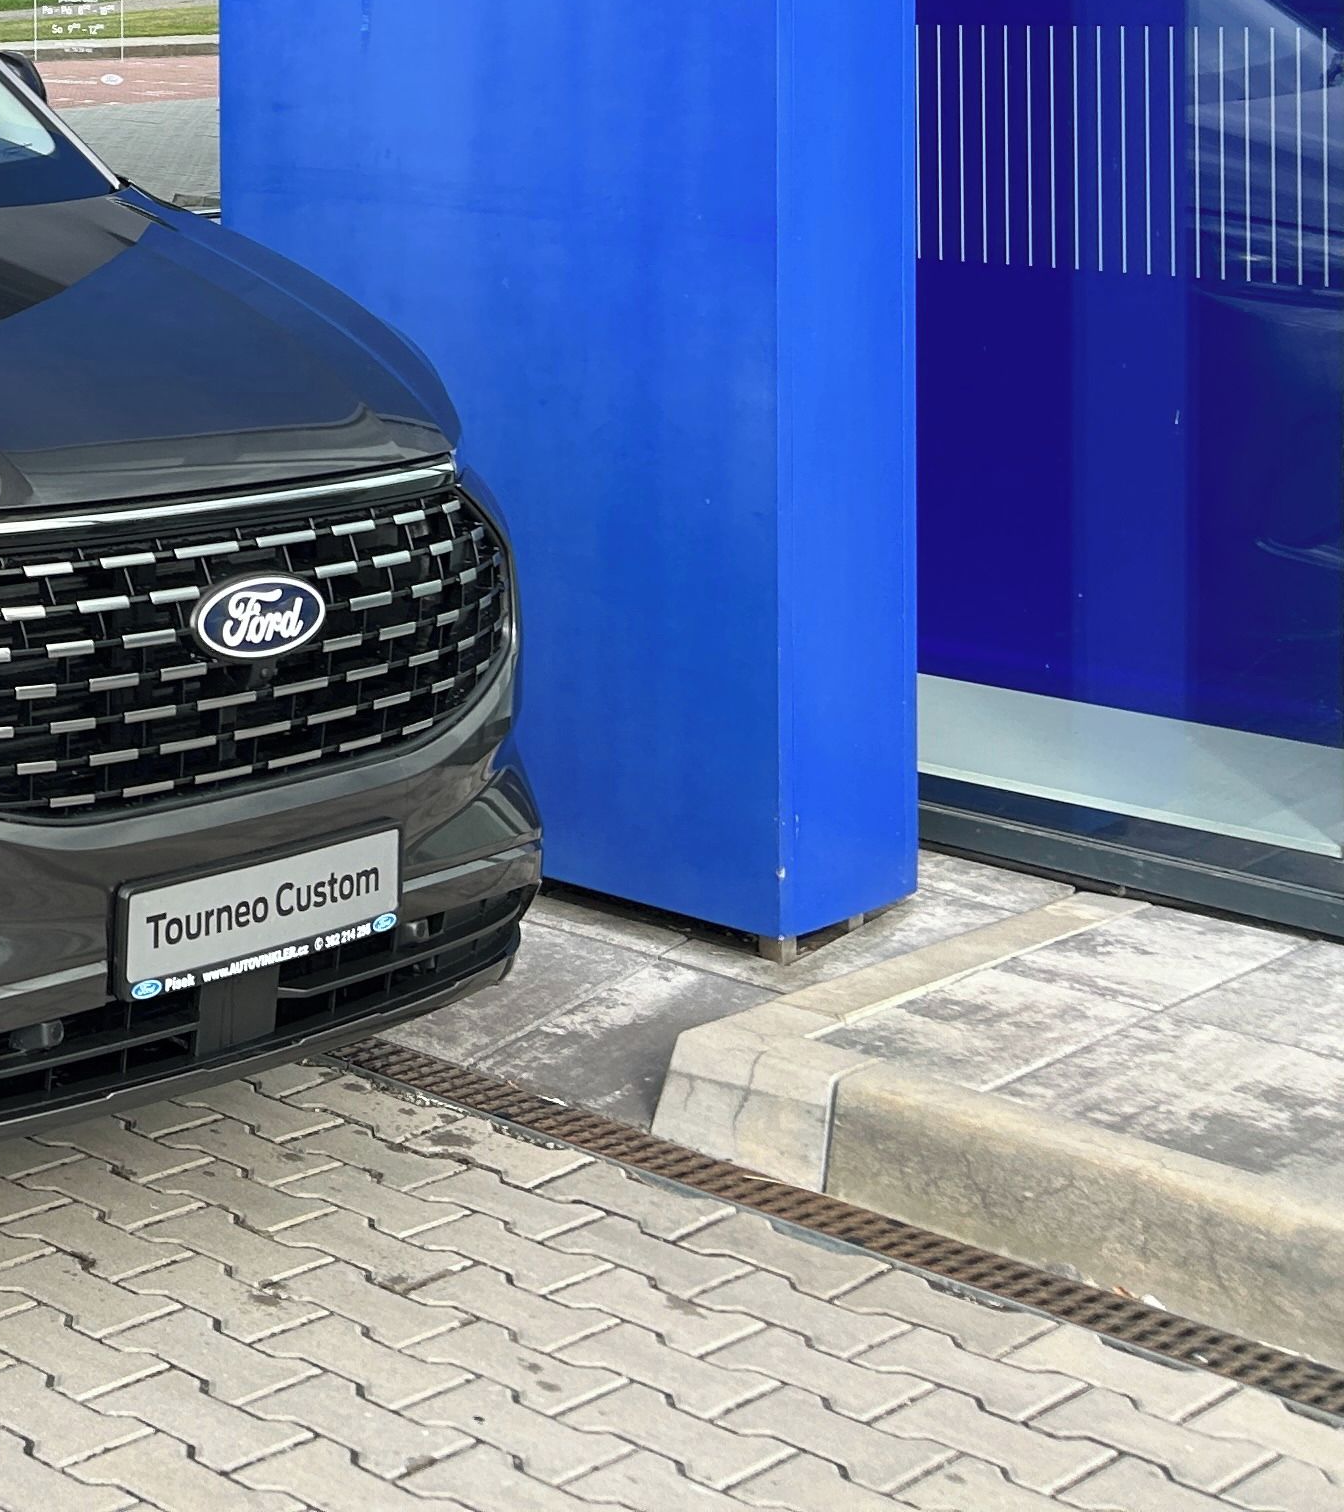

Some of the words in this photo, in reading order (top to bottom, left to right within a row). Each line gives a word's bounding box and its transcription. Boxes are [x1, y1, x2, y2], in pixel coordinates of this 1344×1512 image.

[222, 588, 304, 647] Ford
[146, 896, 268, 949] Tourneo
[276, 866, 380, 917] Custom
